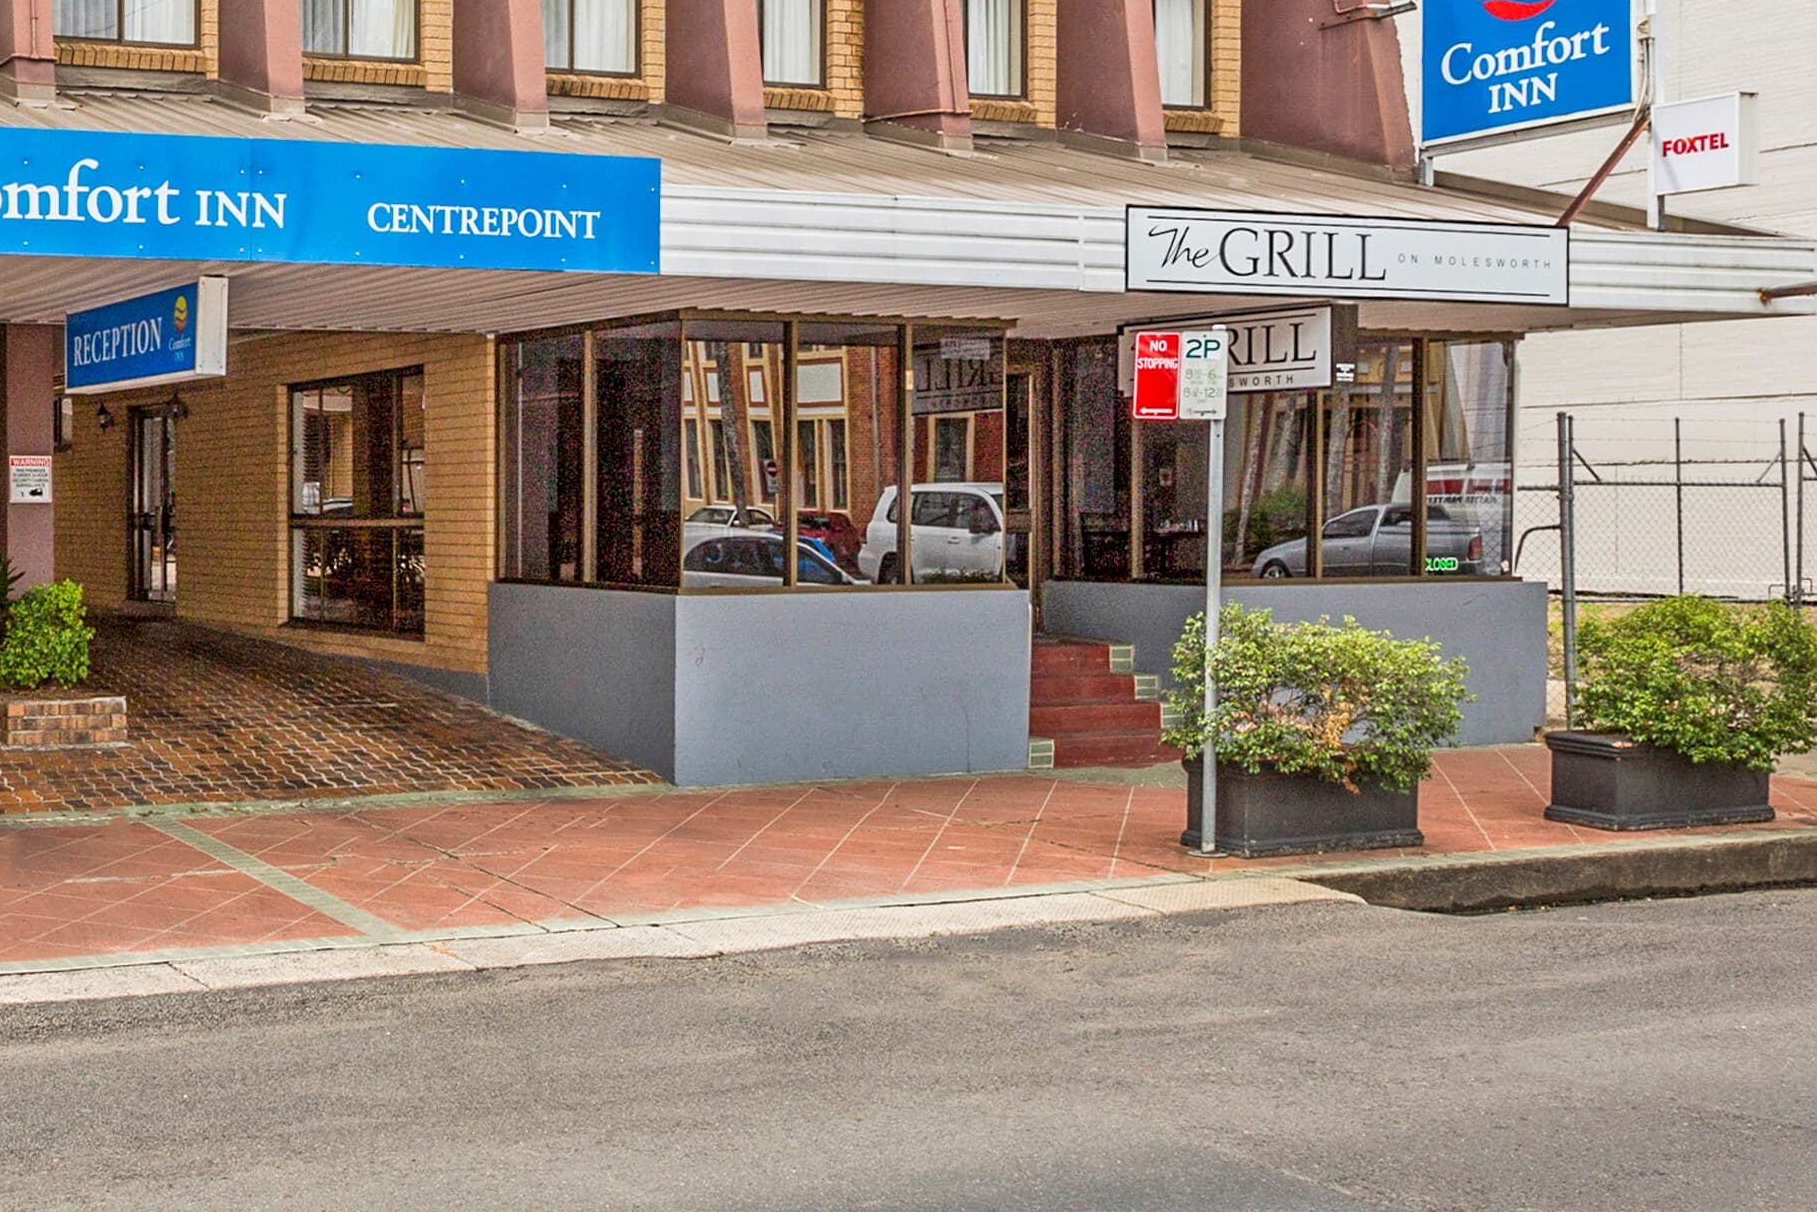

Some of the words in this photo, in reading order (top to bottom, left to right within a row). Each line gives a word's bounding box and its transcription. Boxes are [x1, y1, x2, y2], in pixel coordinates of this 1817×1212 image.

[1440, 20, 1610, 85] Comfort
[1488, 72, 1559, 114] INN
[1662, 131, 1729, 157] FOXTEL
[194, 189, 287, 228] INN
[367, 202, 601, 239] CENTREPOINT
[1148, 225, 1219, 268] The
[1219, 227, 1387, 281] GRILL
[1397, 252, 1419, 264] ON
[1434, 255, 1551, 269] MOLESWORTH
[73, 317, 163, 367] RECEPTION
[1149, 339, 1168, 353] NO
[1185, 338, 1221, 359] 2P
[1226, 322, 1317, 366] RILL
[1137, 356, 1179, 370] STOPPING
[1228, 374, 1295, 387] SWORTH
[13, 458, 50, 466] WARNING
